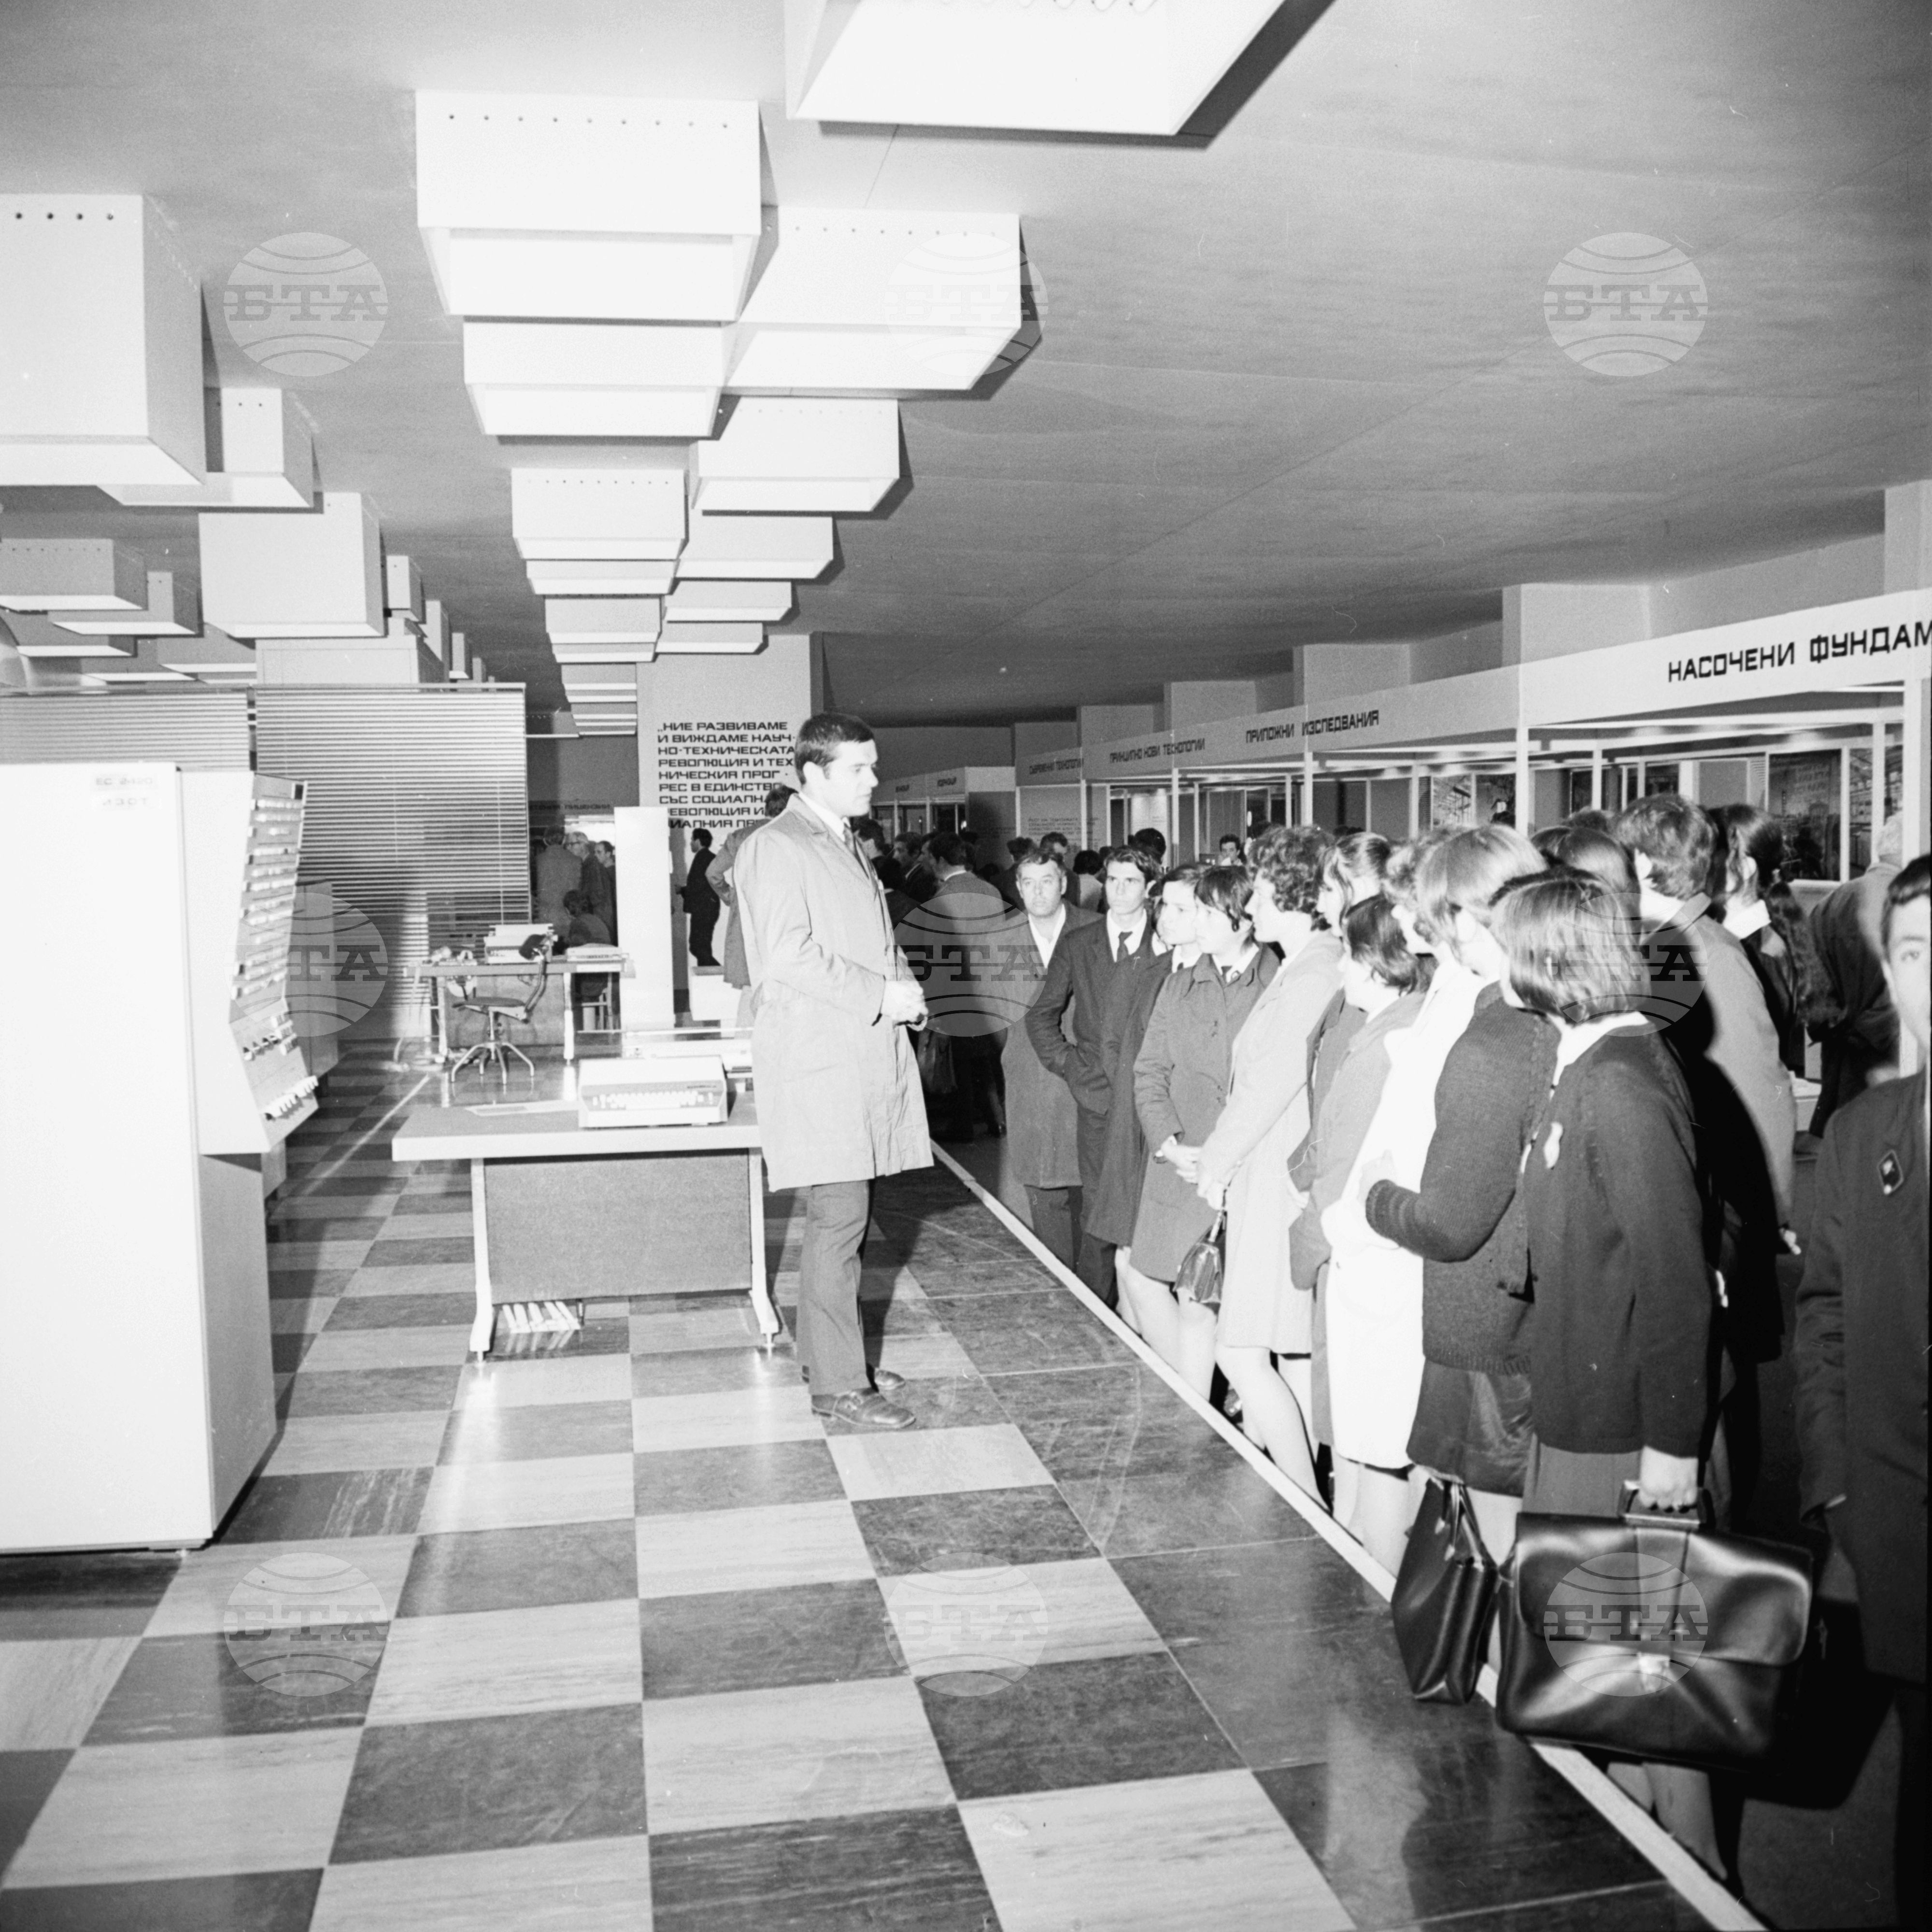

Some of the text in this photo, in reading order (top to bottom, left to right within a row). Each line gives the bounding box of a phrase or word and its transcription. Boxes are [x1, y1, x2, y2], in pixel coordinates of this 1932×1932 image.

[1669, 621, 1932, 682] НАСОЧЕНИ ФУНДАМ
[697, 722, 787, 730] РАЗВИВАМЕ
[1246, 710, 1378, 743] ПРИЛОЖНИ ИЗСЛЕДВАНИЯ
[672, 735, 748, 743] ВИЖДАМЕ
[658, 746, 795, 754] НО-ТЕХНИЧЕСКАТА
[659, 759, 749, 767] РЕВОЛЮЦИЯ
[692, 795, 766, 805] СОЦИАЛН
[668, 807, 751, 817] ЕВОЛЮЦИЯ
